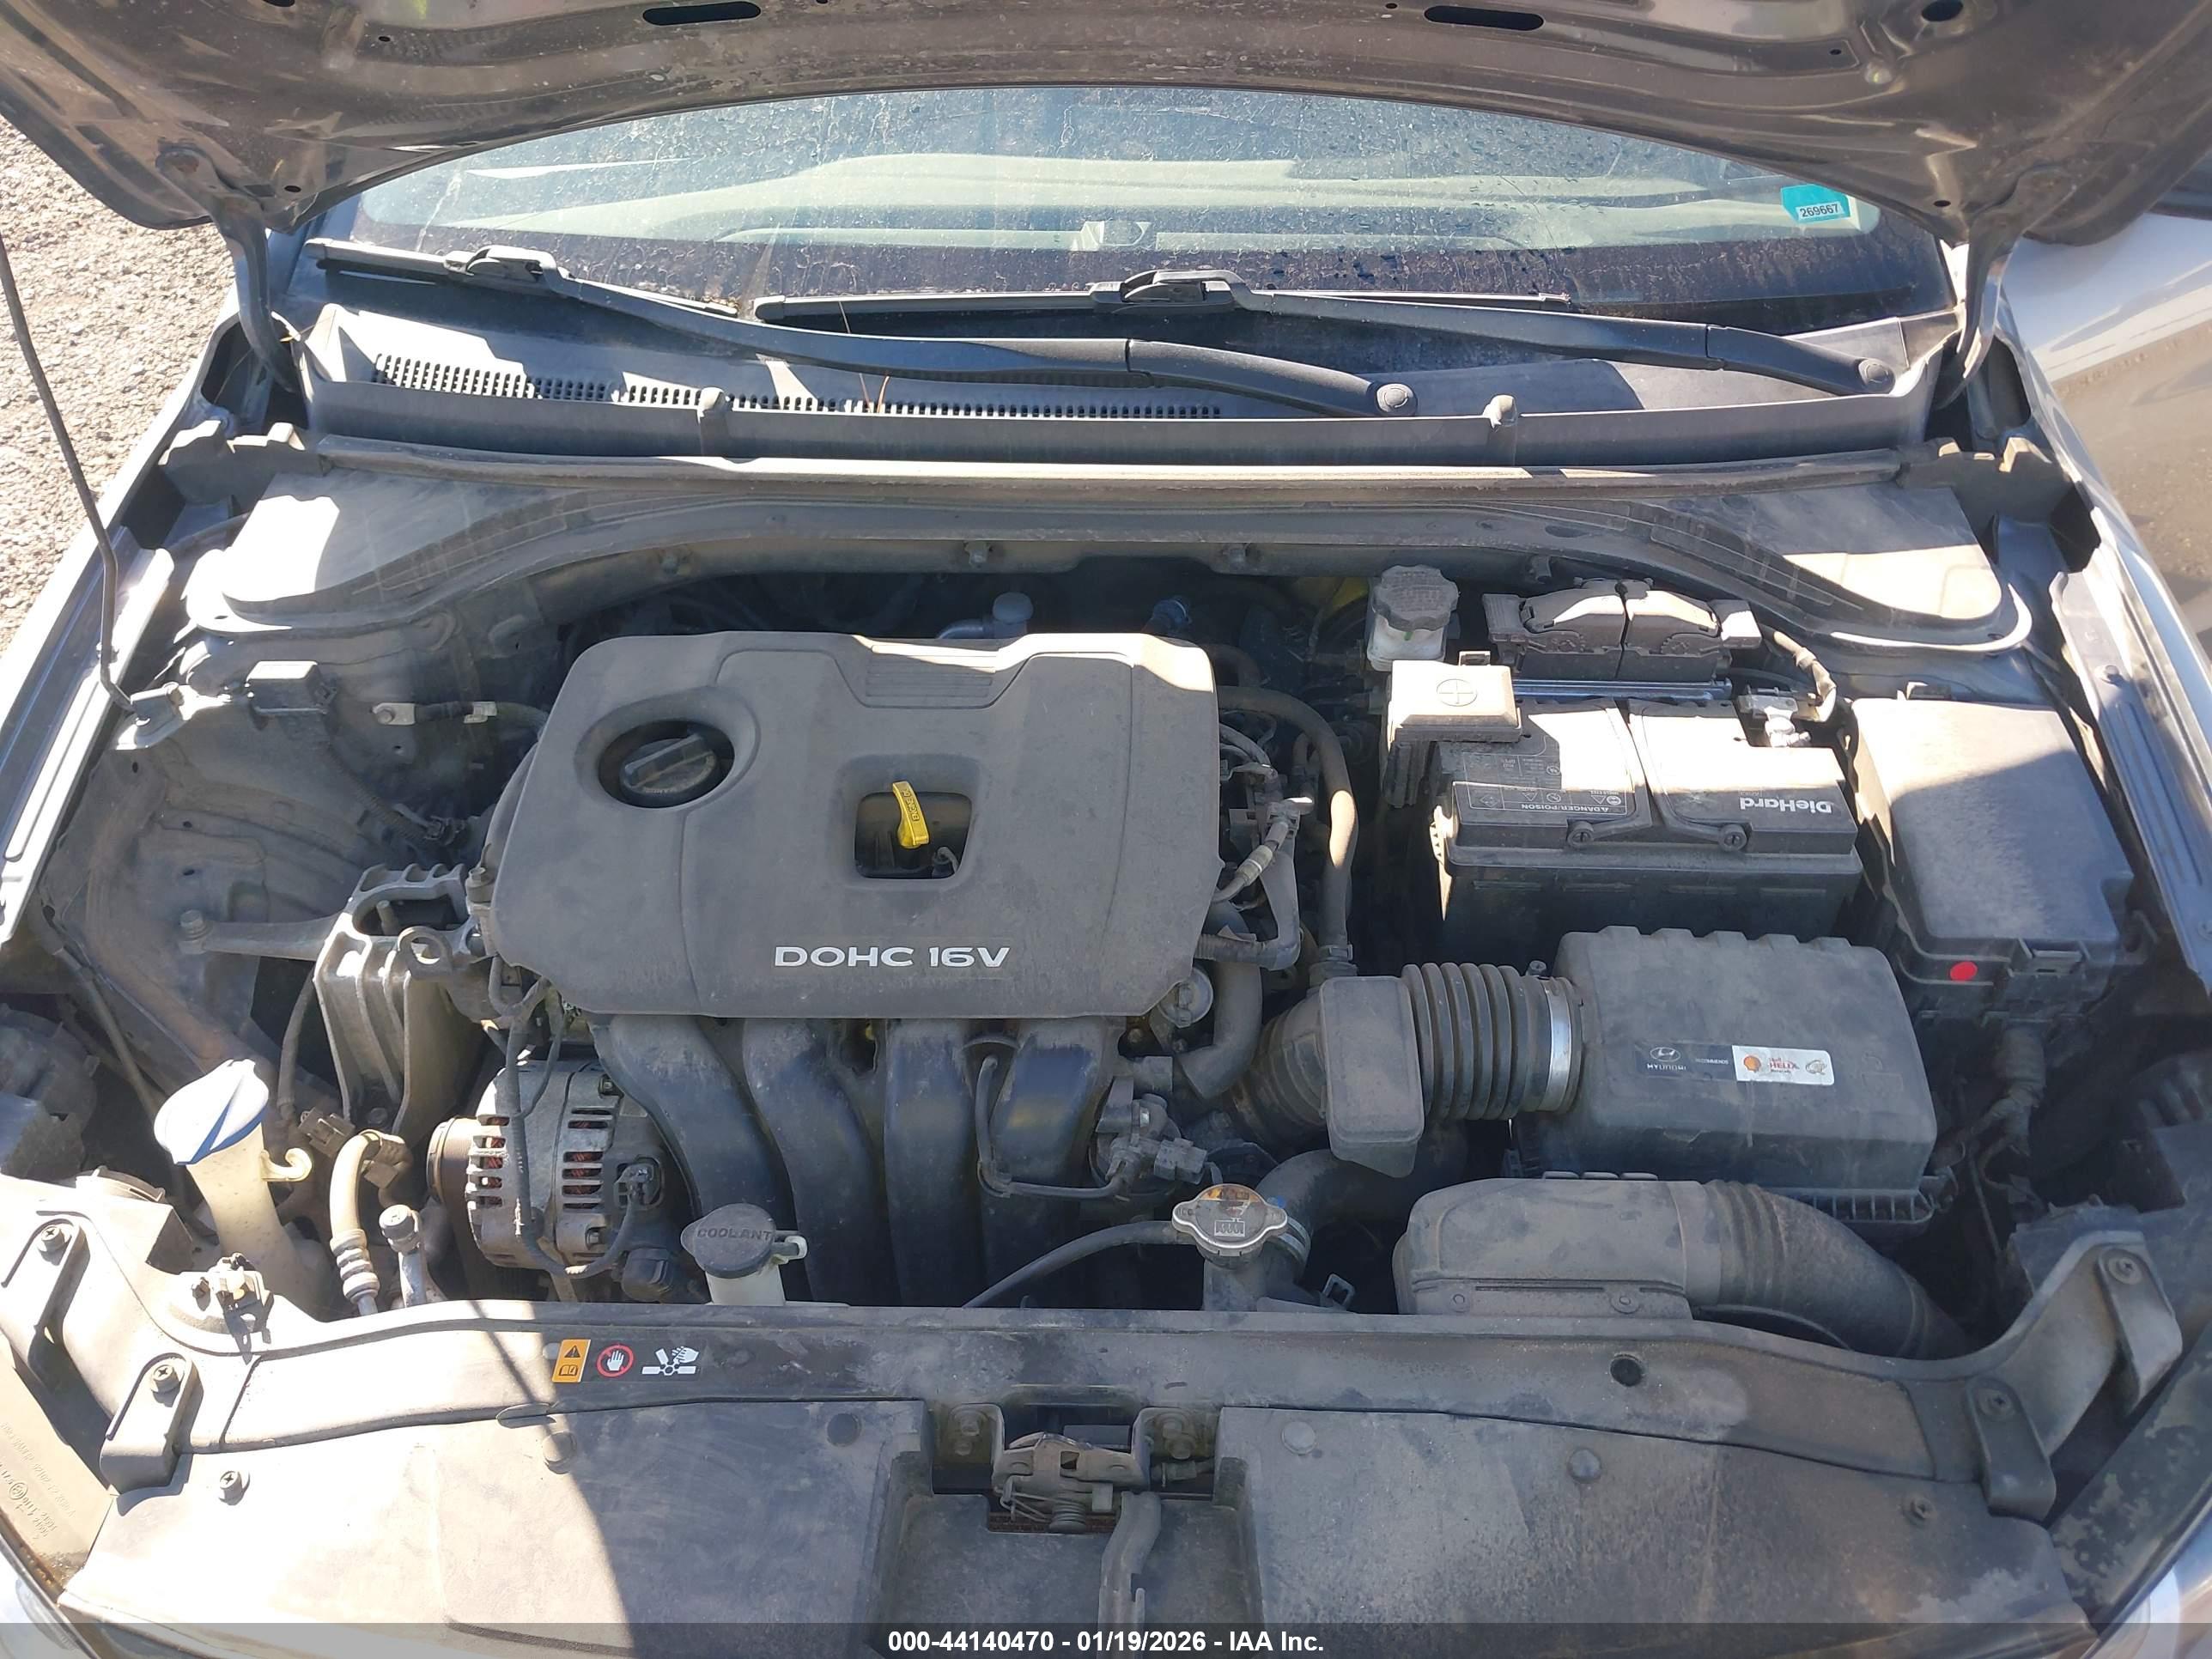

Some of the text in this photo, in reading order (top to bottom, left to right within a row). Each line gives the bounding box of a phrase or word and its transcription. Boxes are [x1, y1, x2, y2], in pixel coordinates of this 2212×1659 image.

[1800, 204, 1838, 217] 269667
[1740, 797, 1832, 814] DieHard
[775, 946, 1011, 968] DOHC 16V
[697, 1228, 772, 1242] COOLANT
